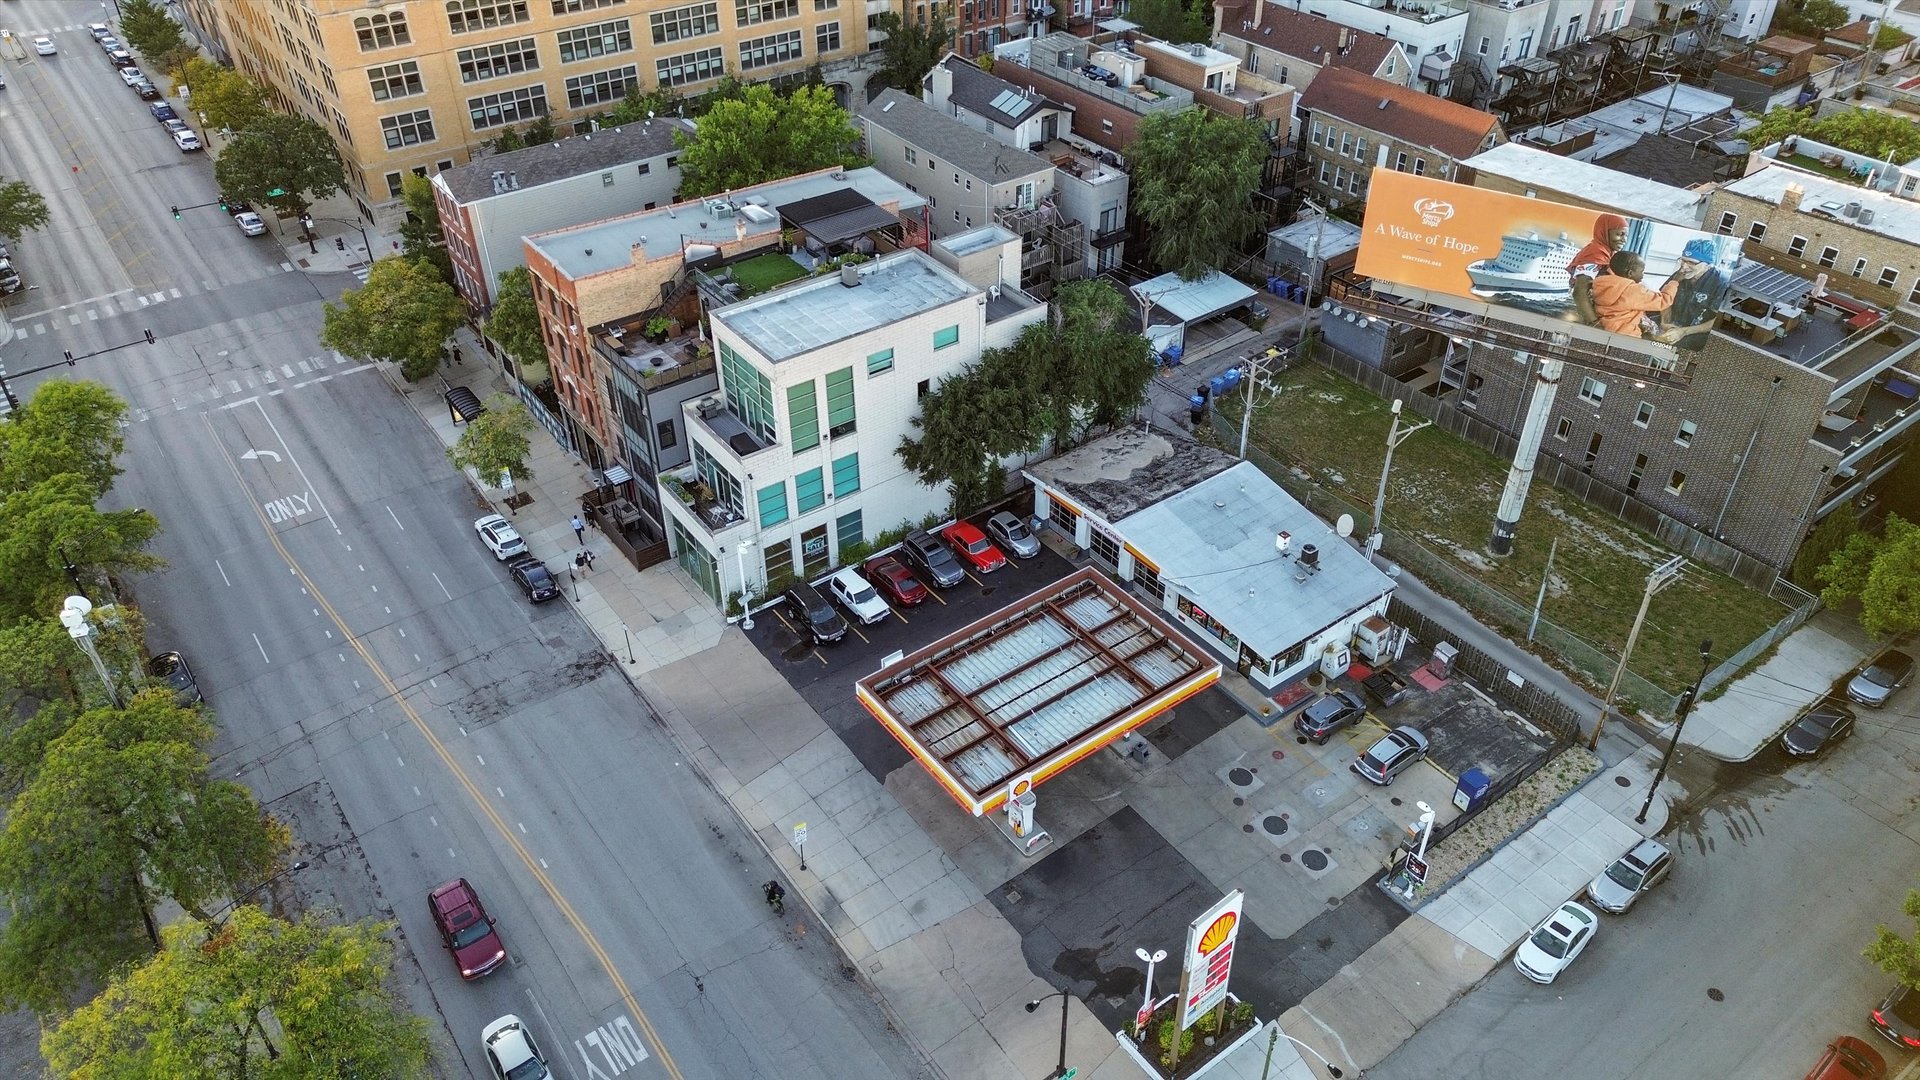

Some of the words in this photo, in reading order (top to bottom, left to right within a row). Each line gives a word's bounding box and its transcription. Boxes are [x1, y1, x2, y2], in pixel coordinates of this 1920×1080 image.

[1422, 212, 1442, 223] Mercy
[1422, 219, 1439, 228] Ships
[1374, 223, 1385, 235] A
[1389, 224, 1423, 242] Wave
[1425, 235, 1441, 246] of
[1443, 236, 1479, 255] Hope
[264, 491, 312, 523] ONLY
[1083, 512, 1104, 531] Service
[1104, 527, 1122, 543] Center
[574, 1014, 650, 1080] ONLY
